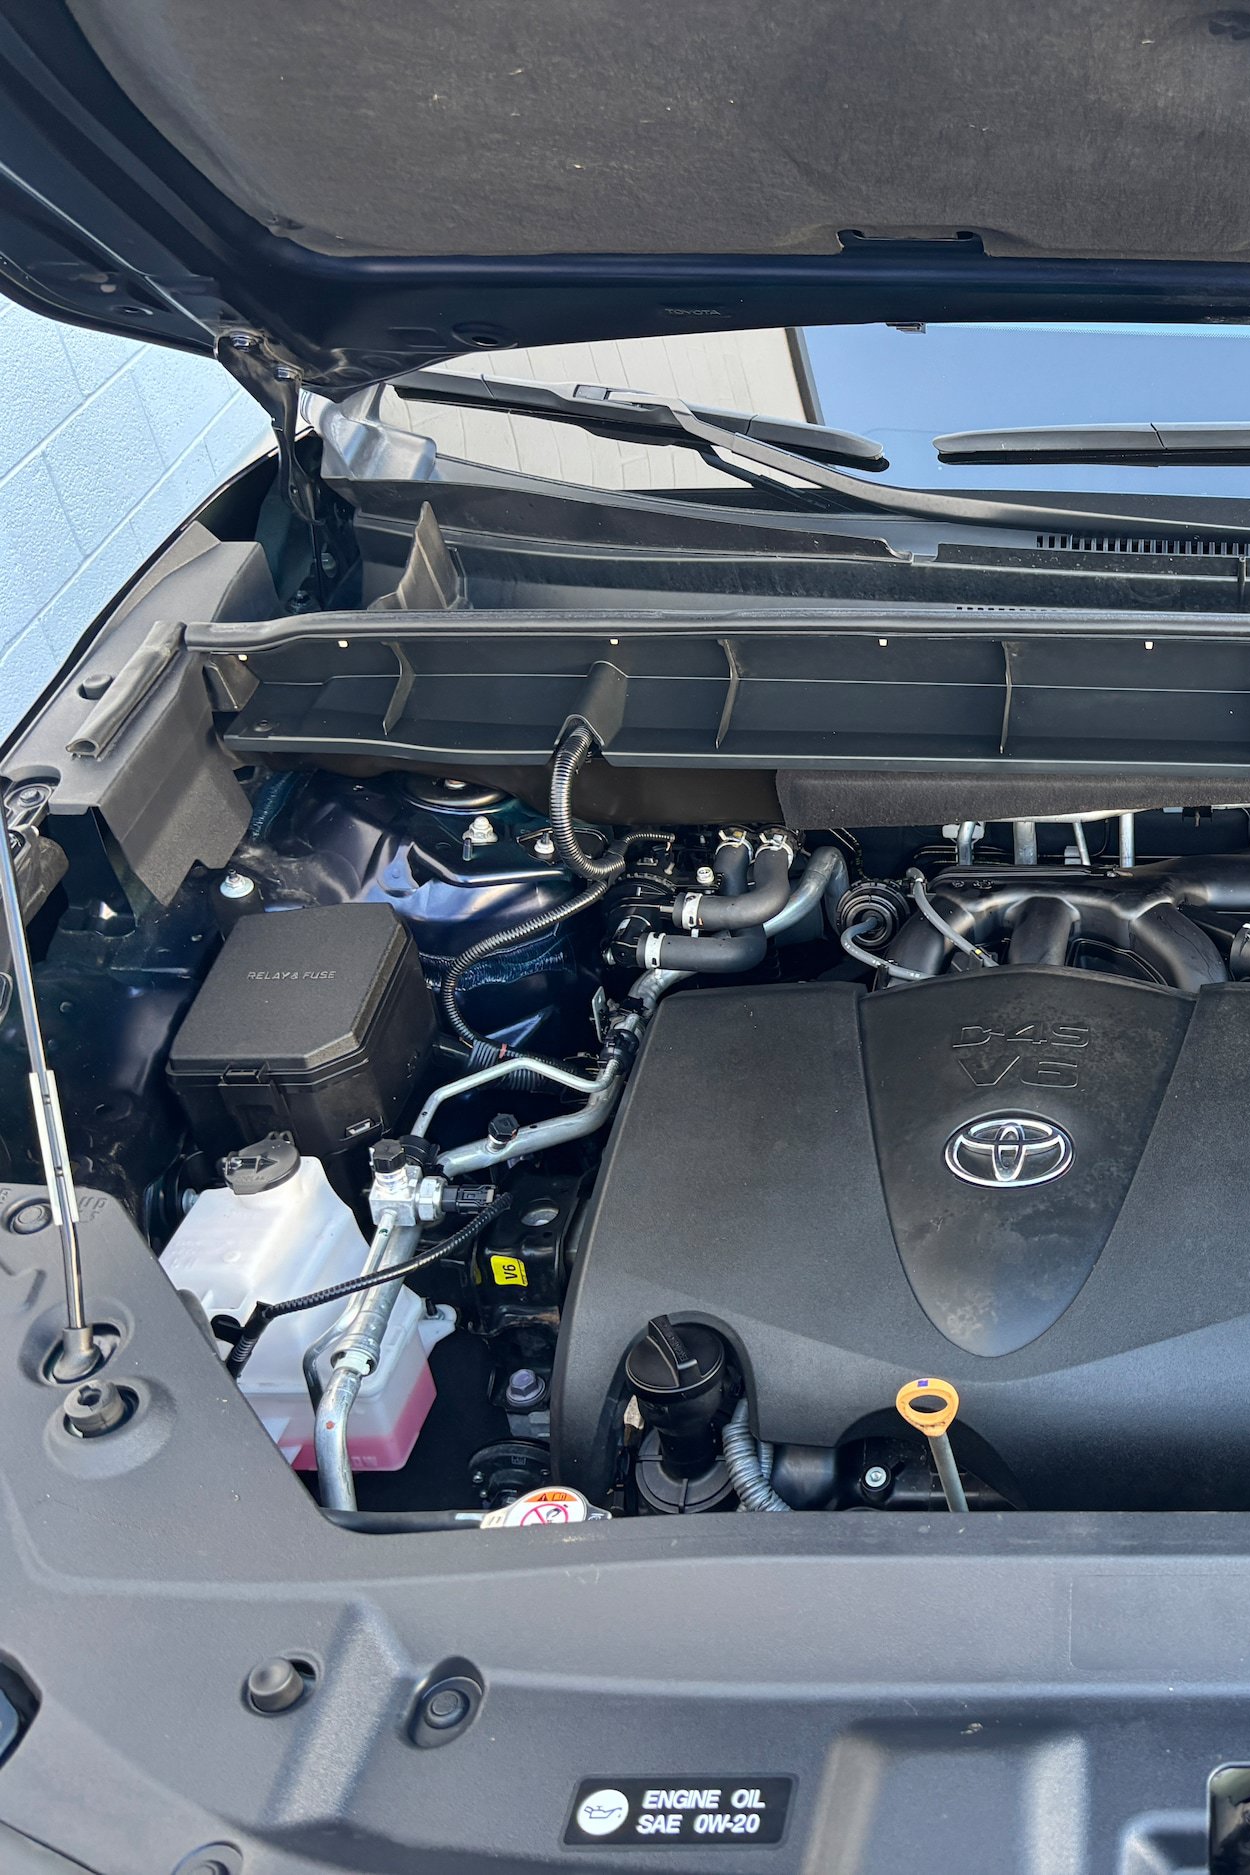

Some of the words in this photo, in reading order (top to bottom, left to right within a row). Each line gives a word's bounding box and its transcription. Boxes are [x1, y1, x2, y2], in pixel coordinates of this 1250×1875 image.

[664, 308, 721, 316] TOYOTA
[247, 971, 290, 980] RELAY
[302, 970, 337, 979] FUSE
[956, 1055, 1080, 1089] V6
[502, 1264, 518, 1279] V6
[641, 1789, 722, 1809] ENGINE
[730, 1789, 766, 1809] OIL
[635, 1814, 683, 1835] SAE
[693, 1814, 761, 1834] 0W-20
